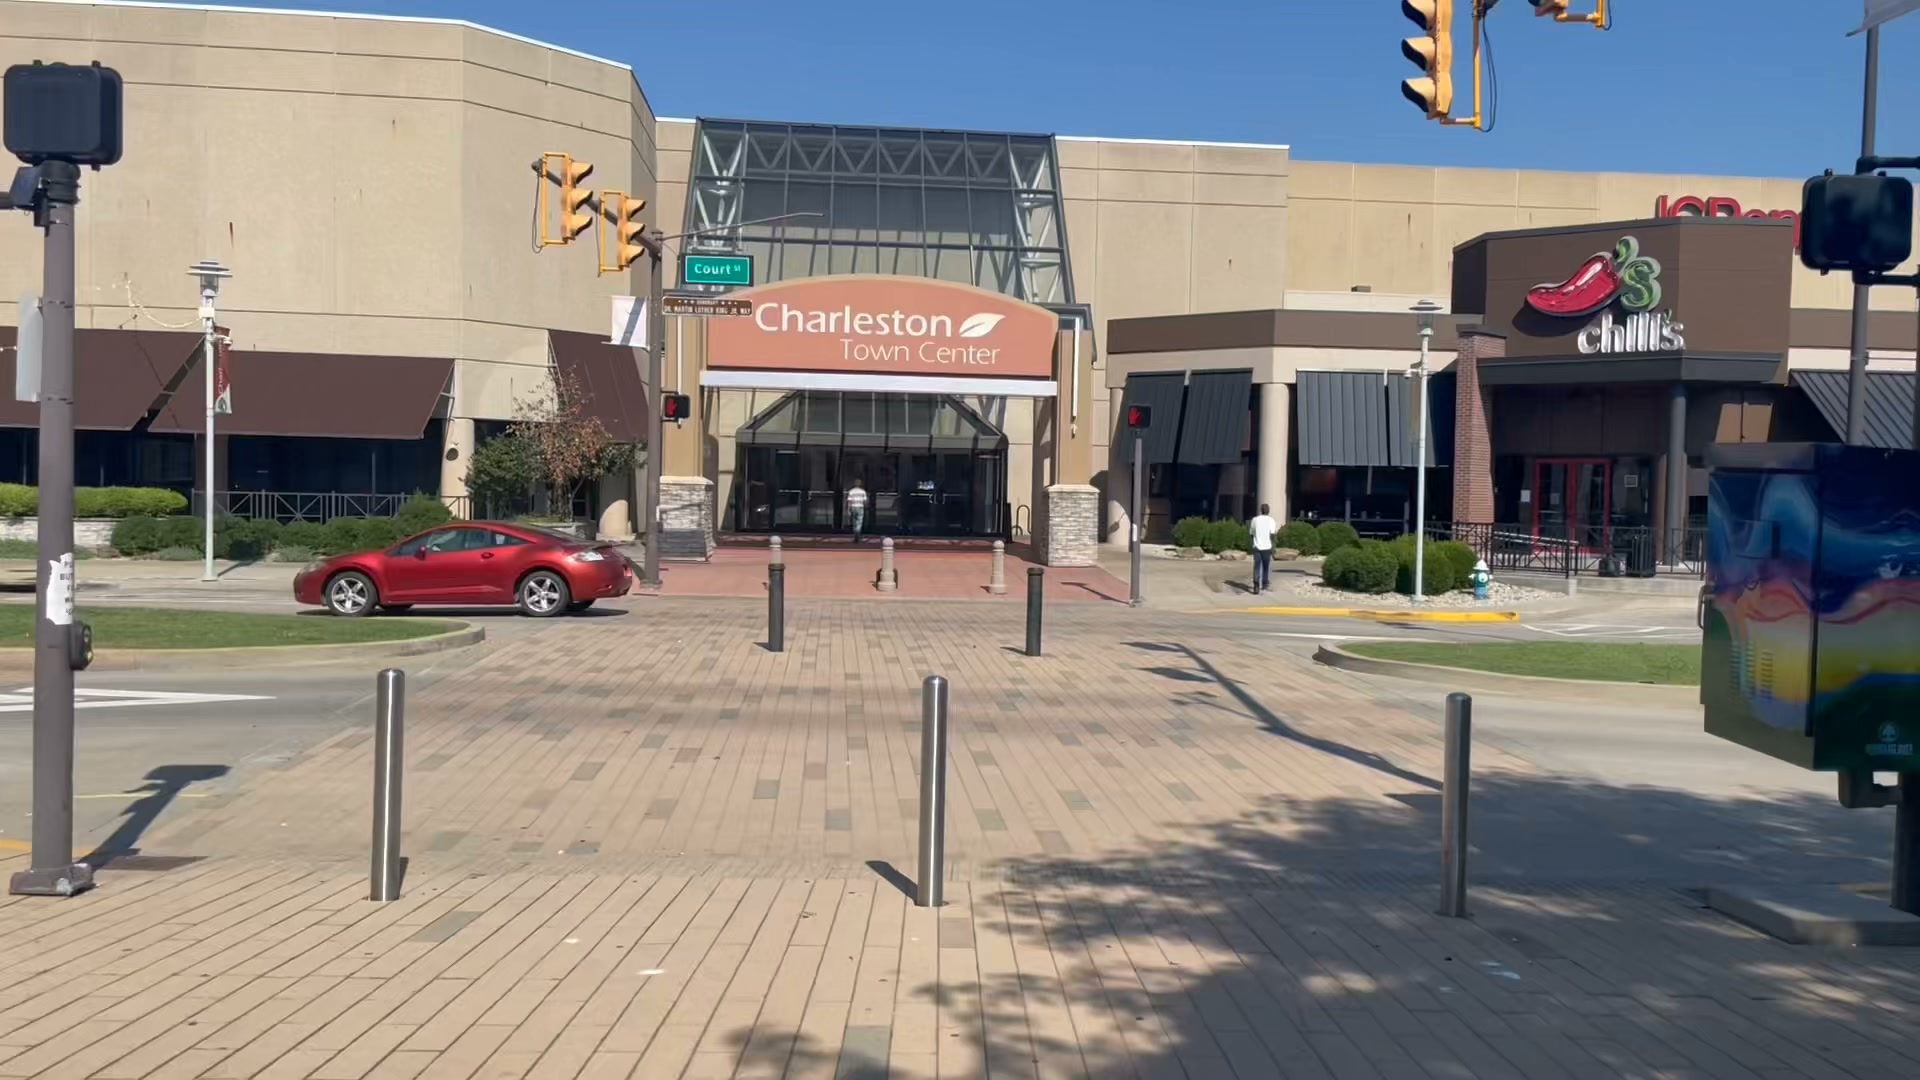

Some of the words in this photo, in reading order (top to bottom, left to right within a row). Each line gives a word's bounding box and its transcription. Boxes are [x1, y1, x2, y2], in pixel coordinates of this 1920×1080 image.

[694, 263, 731, 275] Court
[755, 302, 952, 337] Charleston
[840, 338, 910, 361] Town
[919, 341, 1000, 365] Center
